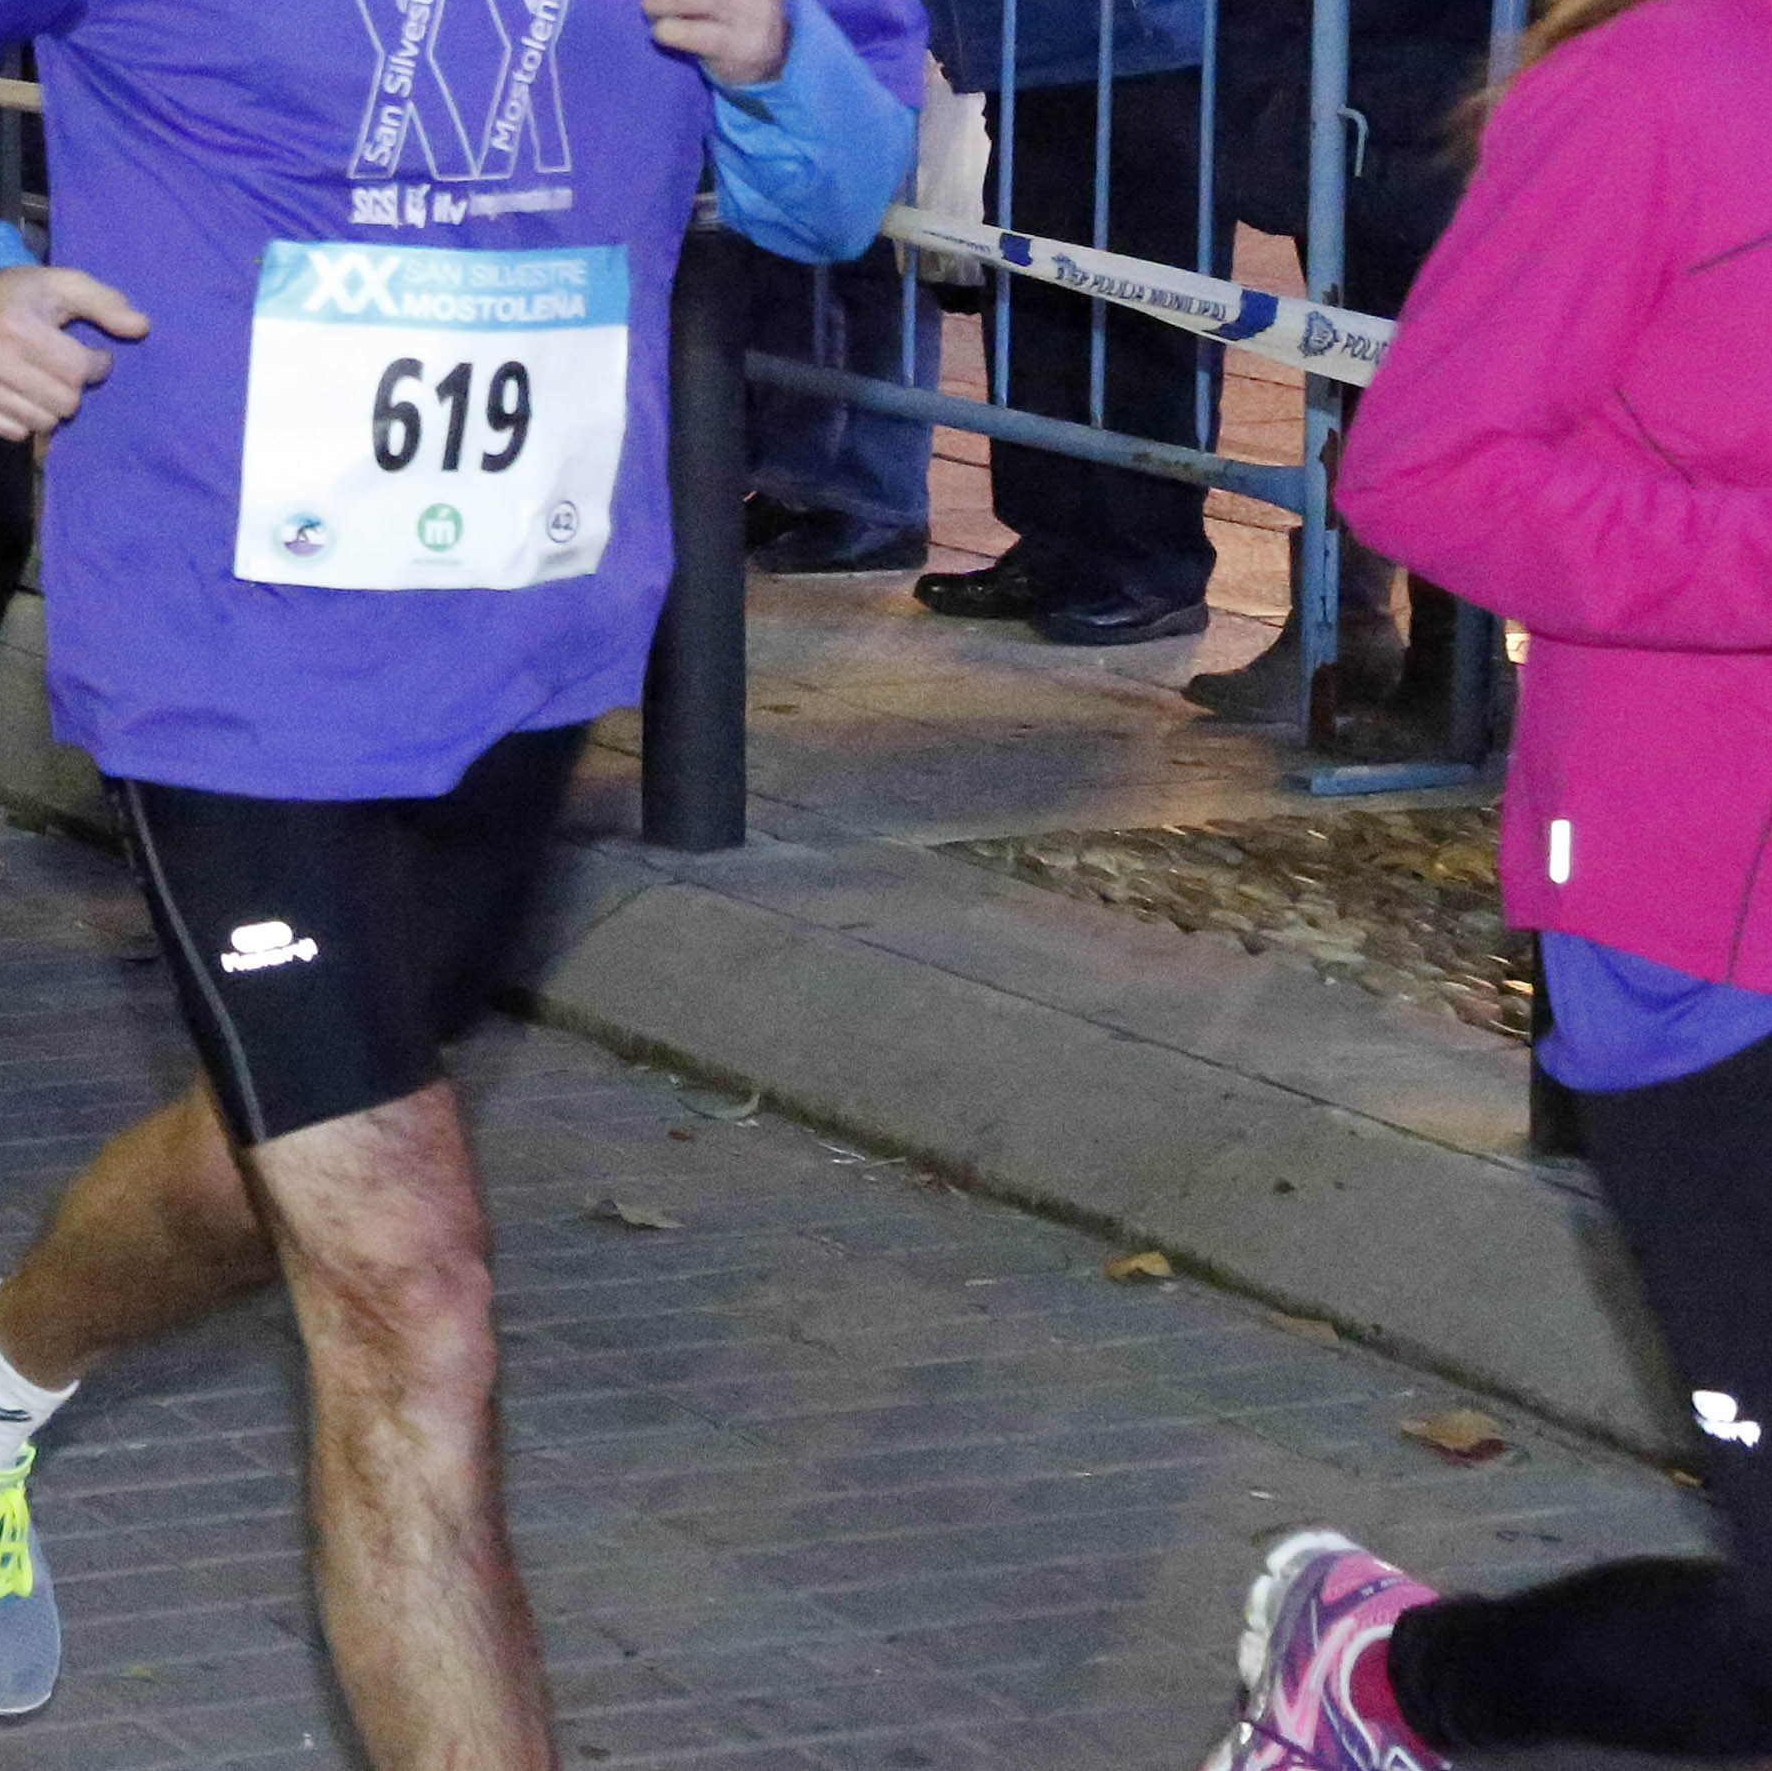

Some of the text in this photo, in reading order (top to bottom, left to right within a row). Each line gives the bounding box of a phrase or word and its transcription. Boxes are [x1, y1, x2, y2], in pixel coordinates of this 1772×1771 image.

[362, 104, 405, 168] San
[304, 250, 588, 317] XX SAN SILVESTRE
[402, 289, 587, 322] MOSTOLEÑA
[371, 356, 533, 474] 619
